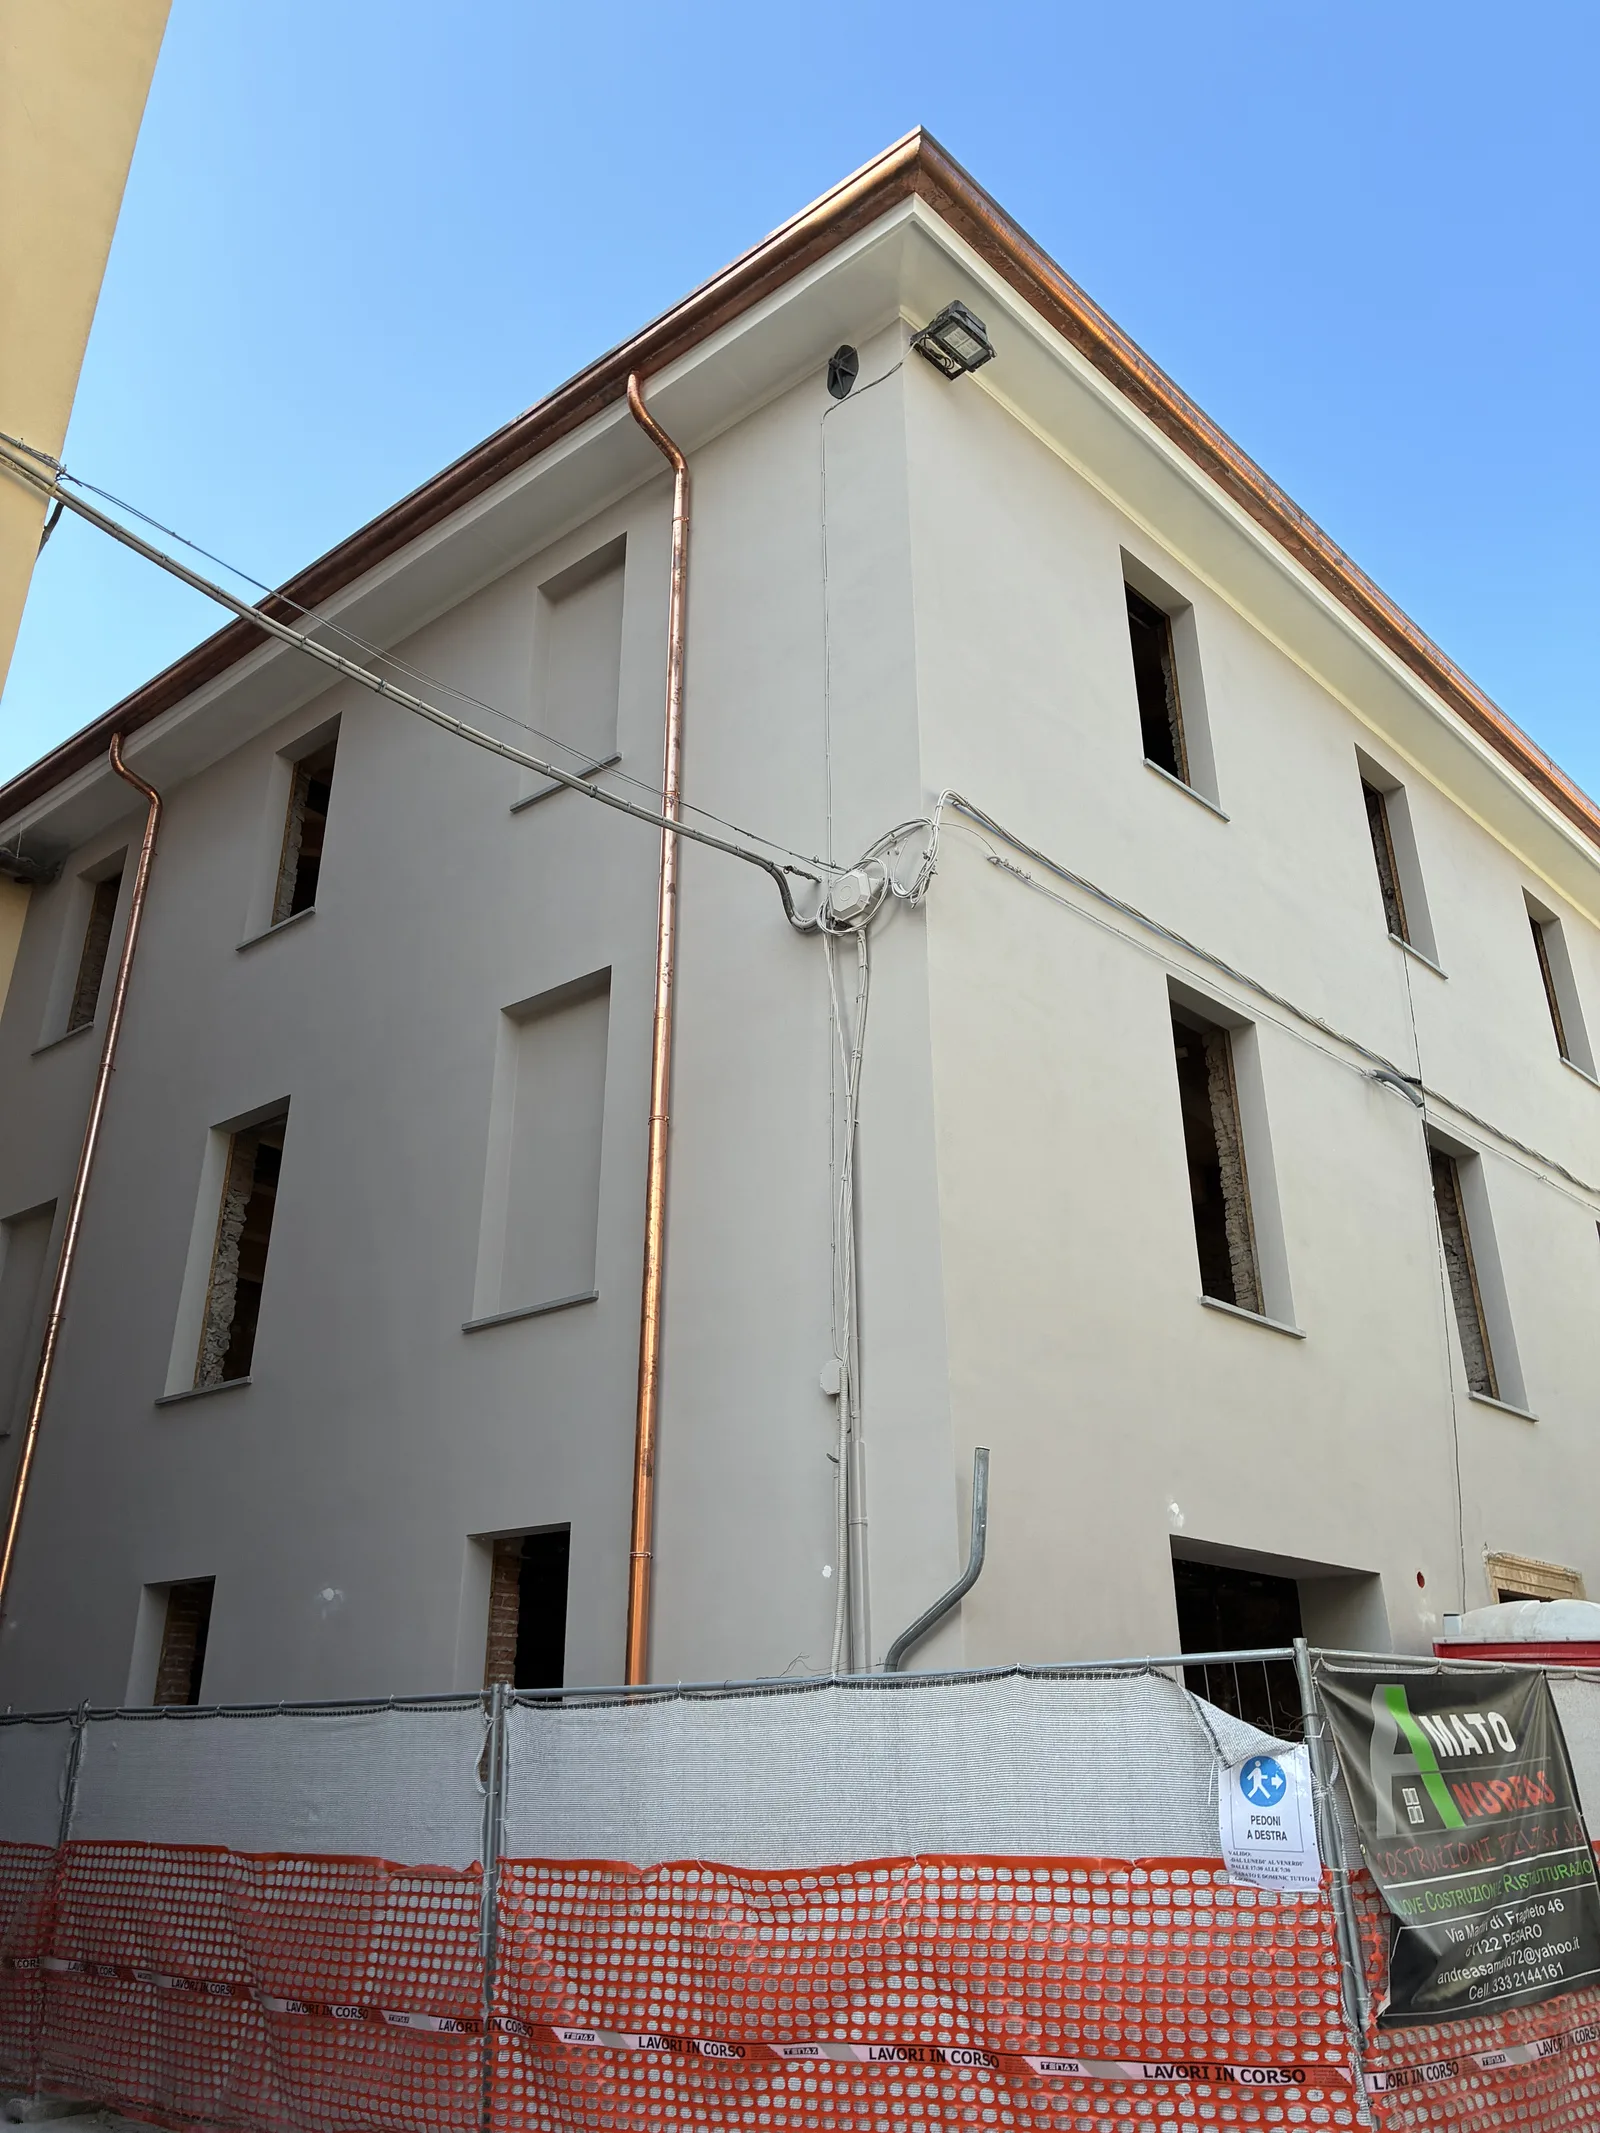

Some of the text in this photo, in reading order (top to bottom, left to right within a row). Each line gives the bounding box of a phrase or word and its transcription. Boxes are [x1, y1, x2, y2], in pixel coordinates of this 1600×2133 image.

[1250, 1815, 1281, 1826] PEDONI
[1247, 1829, 1288, 1841] A DESTRA
[1445, 1927, 1465, 1943] Via
[1490, 1914, 1504, 1930] di
[1547, 1898, 1565, 1914] 46
[1502, 1923, 1542, 1948] PESARO
[171, 1978, 199, 1991] LAVORI
[210, 1983, 236, 1996] CORSO
[1469, 1961, 1564, 2000] Cell. 333 2144161
[285, 2001, 368, 2020] LAVORI IN CORSO
[438, 2019, 480, 2033] LAVORI
[505, 2020, 534, 2037] CORSO
[638, 2036, 683, 2052] LAVORI
[685, 2039, 700, 2053] IN
[703, 2043, 746, 2058] CORSO
[868, 2047, 925, 2062] LAVORI
[929, 2049, 946, 2063] IN
[950, 2050, 1000, 2069] CORSO
[1143, 2065, 1209, 2080] LAVORI
[1215, 2066, 1235, 2082] IN
[1240, 2068, 1306, 2084] CORSO
[1373, 2070, 1409, 2090] LORI
[1411, 2067, 1425, 2084] IN
[1426, 2061, 1459, 2081] CORSO
